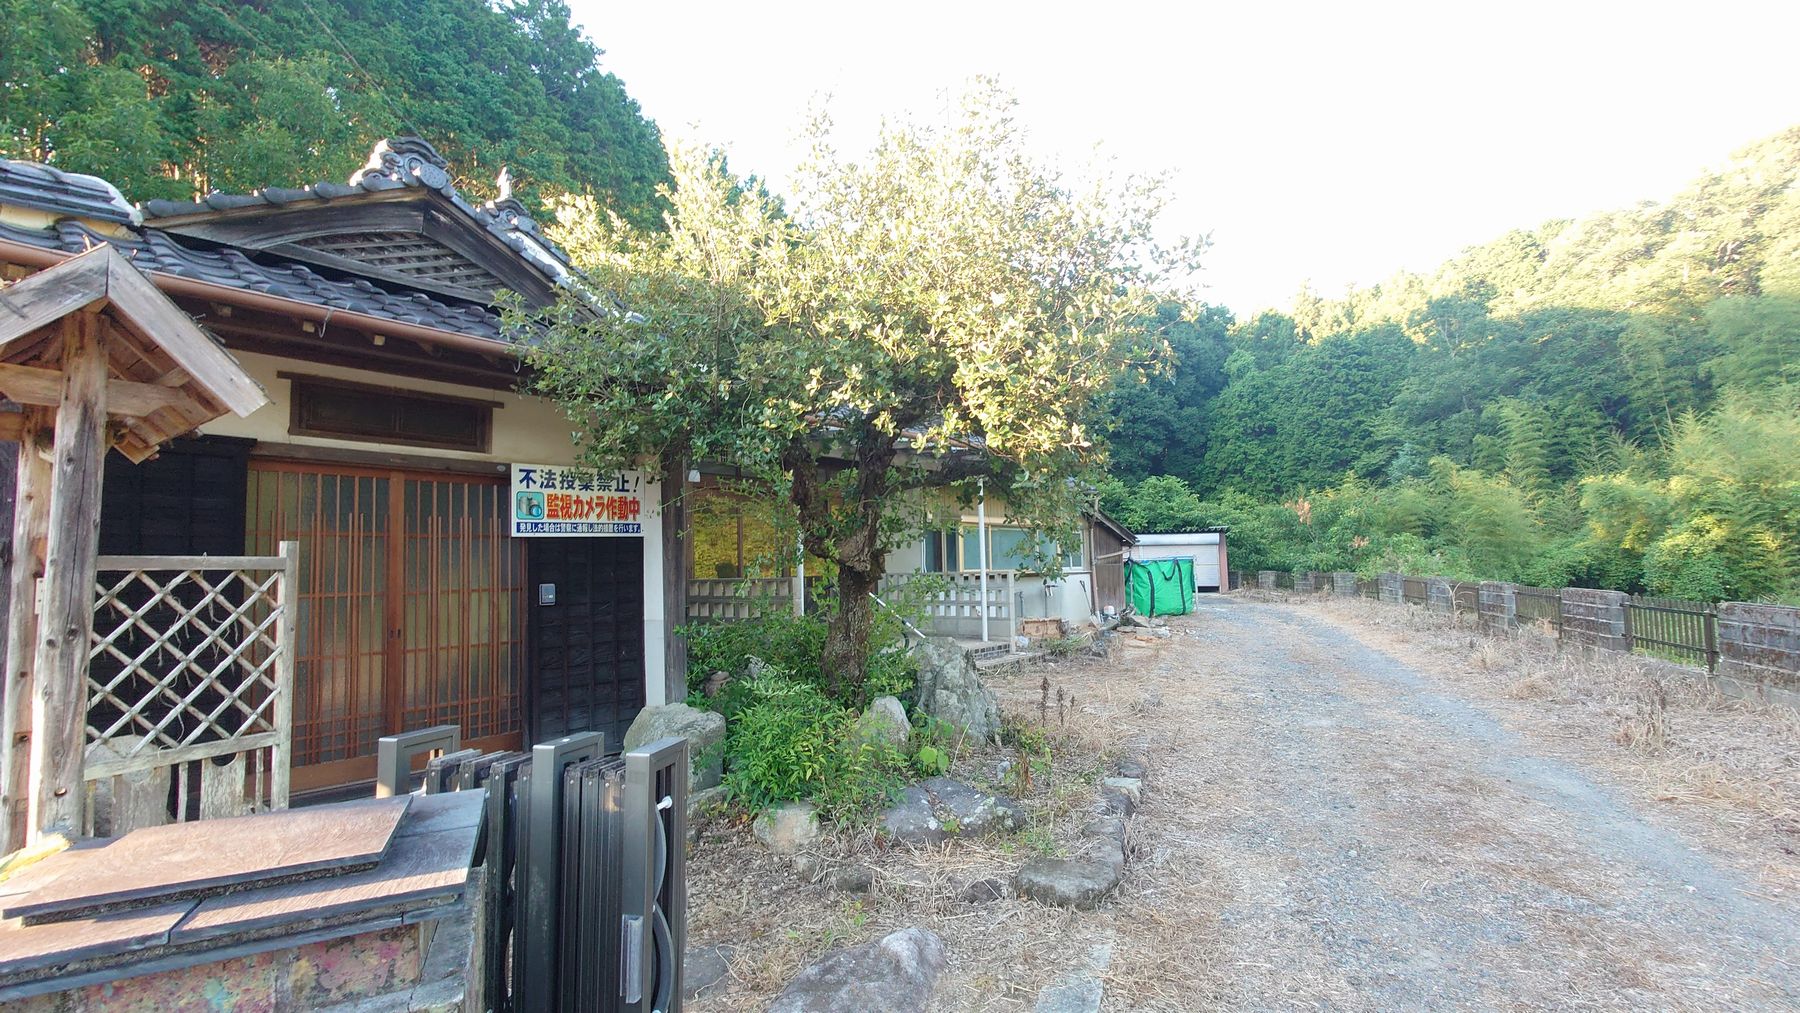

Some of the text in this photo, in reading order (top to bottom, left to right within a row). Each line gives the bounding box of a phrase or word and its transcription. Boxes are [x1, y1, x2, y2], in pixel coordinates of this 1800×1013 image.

[546, 493, 640, 521] 監視カメラ作動中
